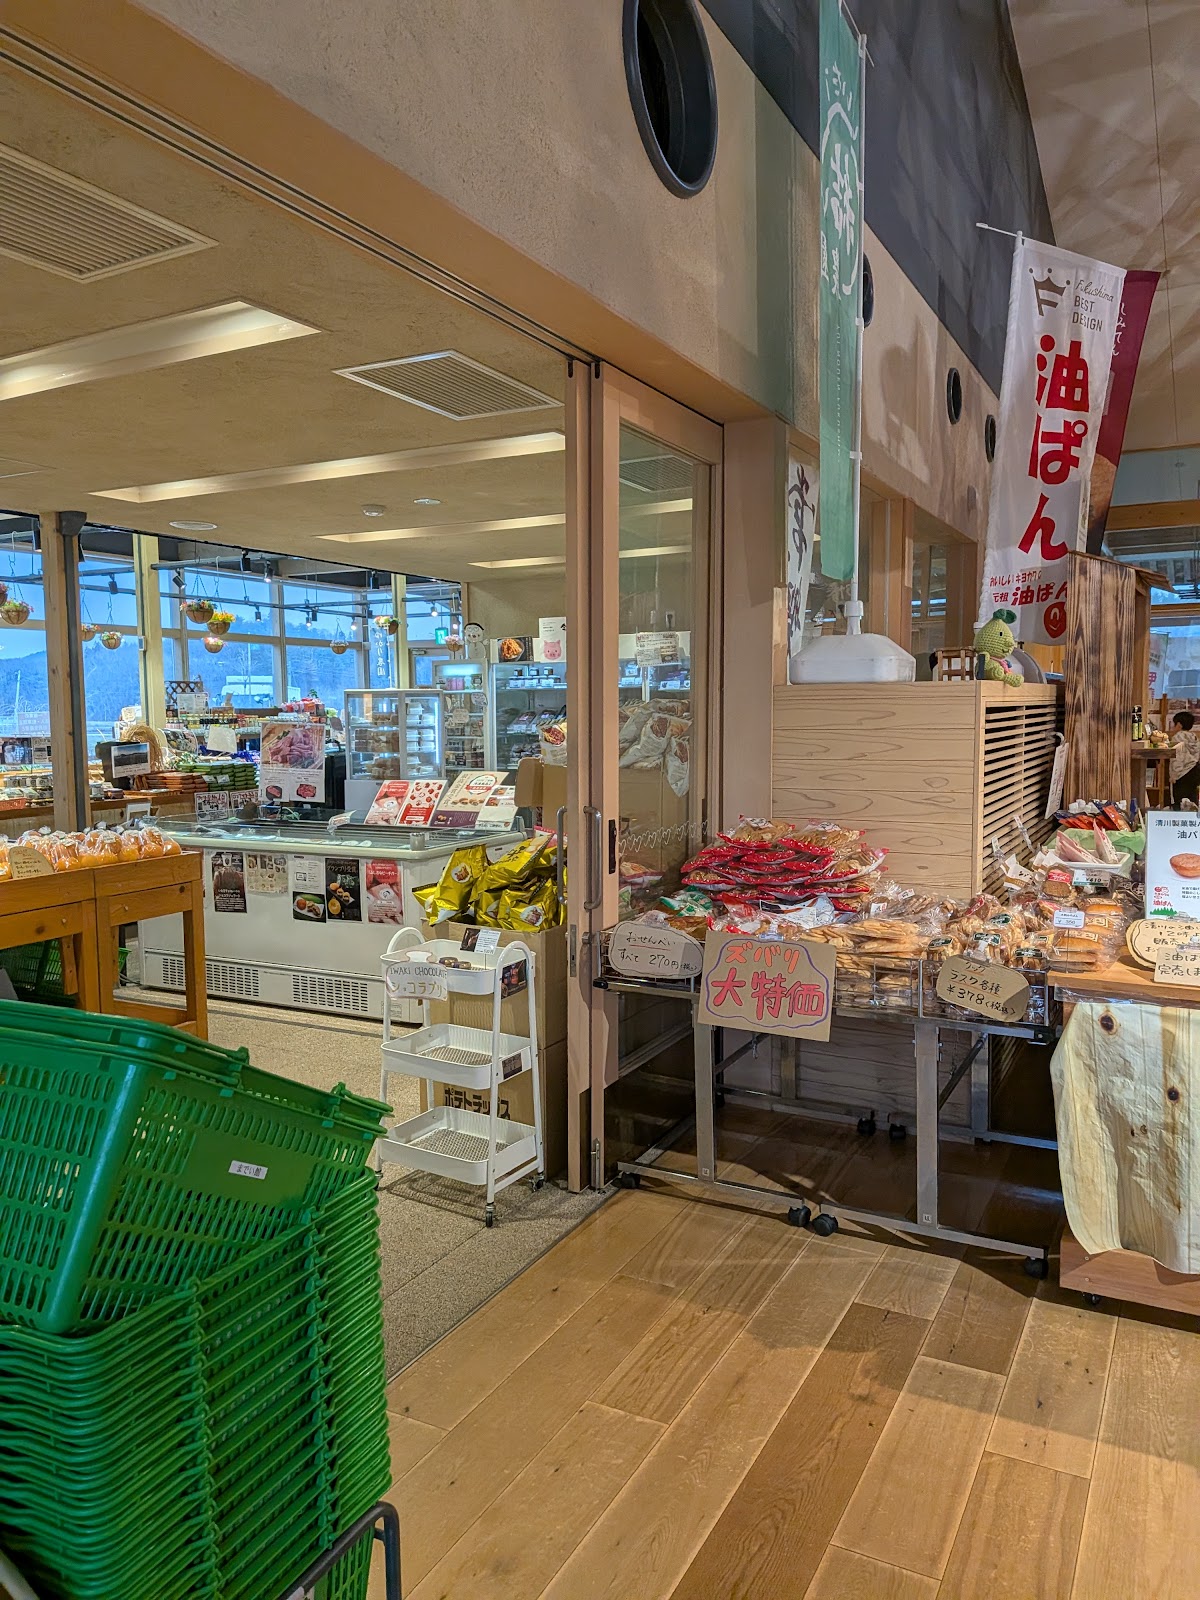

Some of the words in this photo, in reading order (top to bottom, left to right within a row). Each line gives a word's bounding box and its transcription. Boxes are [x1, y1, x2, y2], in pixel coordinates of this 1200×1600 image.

[1075, 279, 1114, 302] Fukushima
[1074, 295, 1095, 313] BEST
[1072, 311, 1103, 332] DESIGN
[1018, 334, 1090, 561] 油ぱん
[725, 941, 800, 974] ズバリ
[711, 967, 825, 1020] 大特価
[950, 969, 1002, 995] ラスク各種
